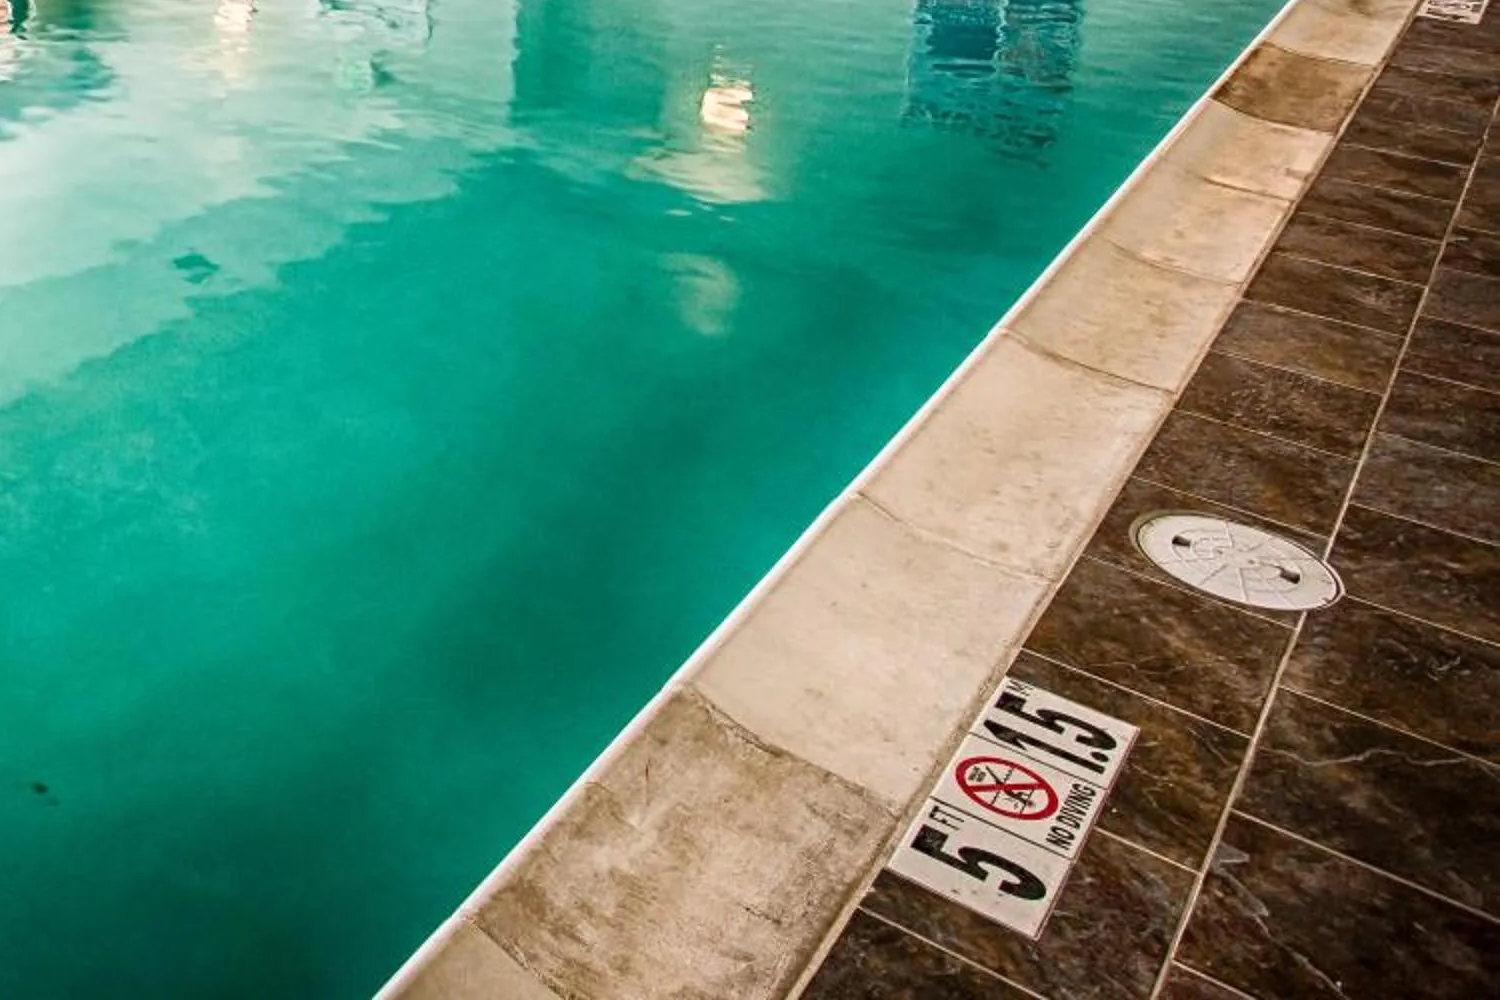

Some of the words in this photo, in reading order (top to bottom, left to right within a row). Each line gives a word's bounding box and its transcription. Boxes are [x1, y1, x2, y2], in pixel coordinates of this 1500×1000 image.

[983, 691, 1117, 775] 1.5
[928, 805, 965, 832] FT
[1055, 783, 1097, 830] DIVING
[1045, 825, 1075, 851] NO
[909, 823, 1047, 901] 5
